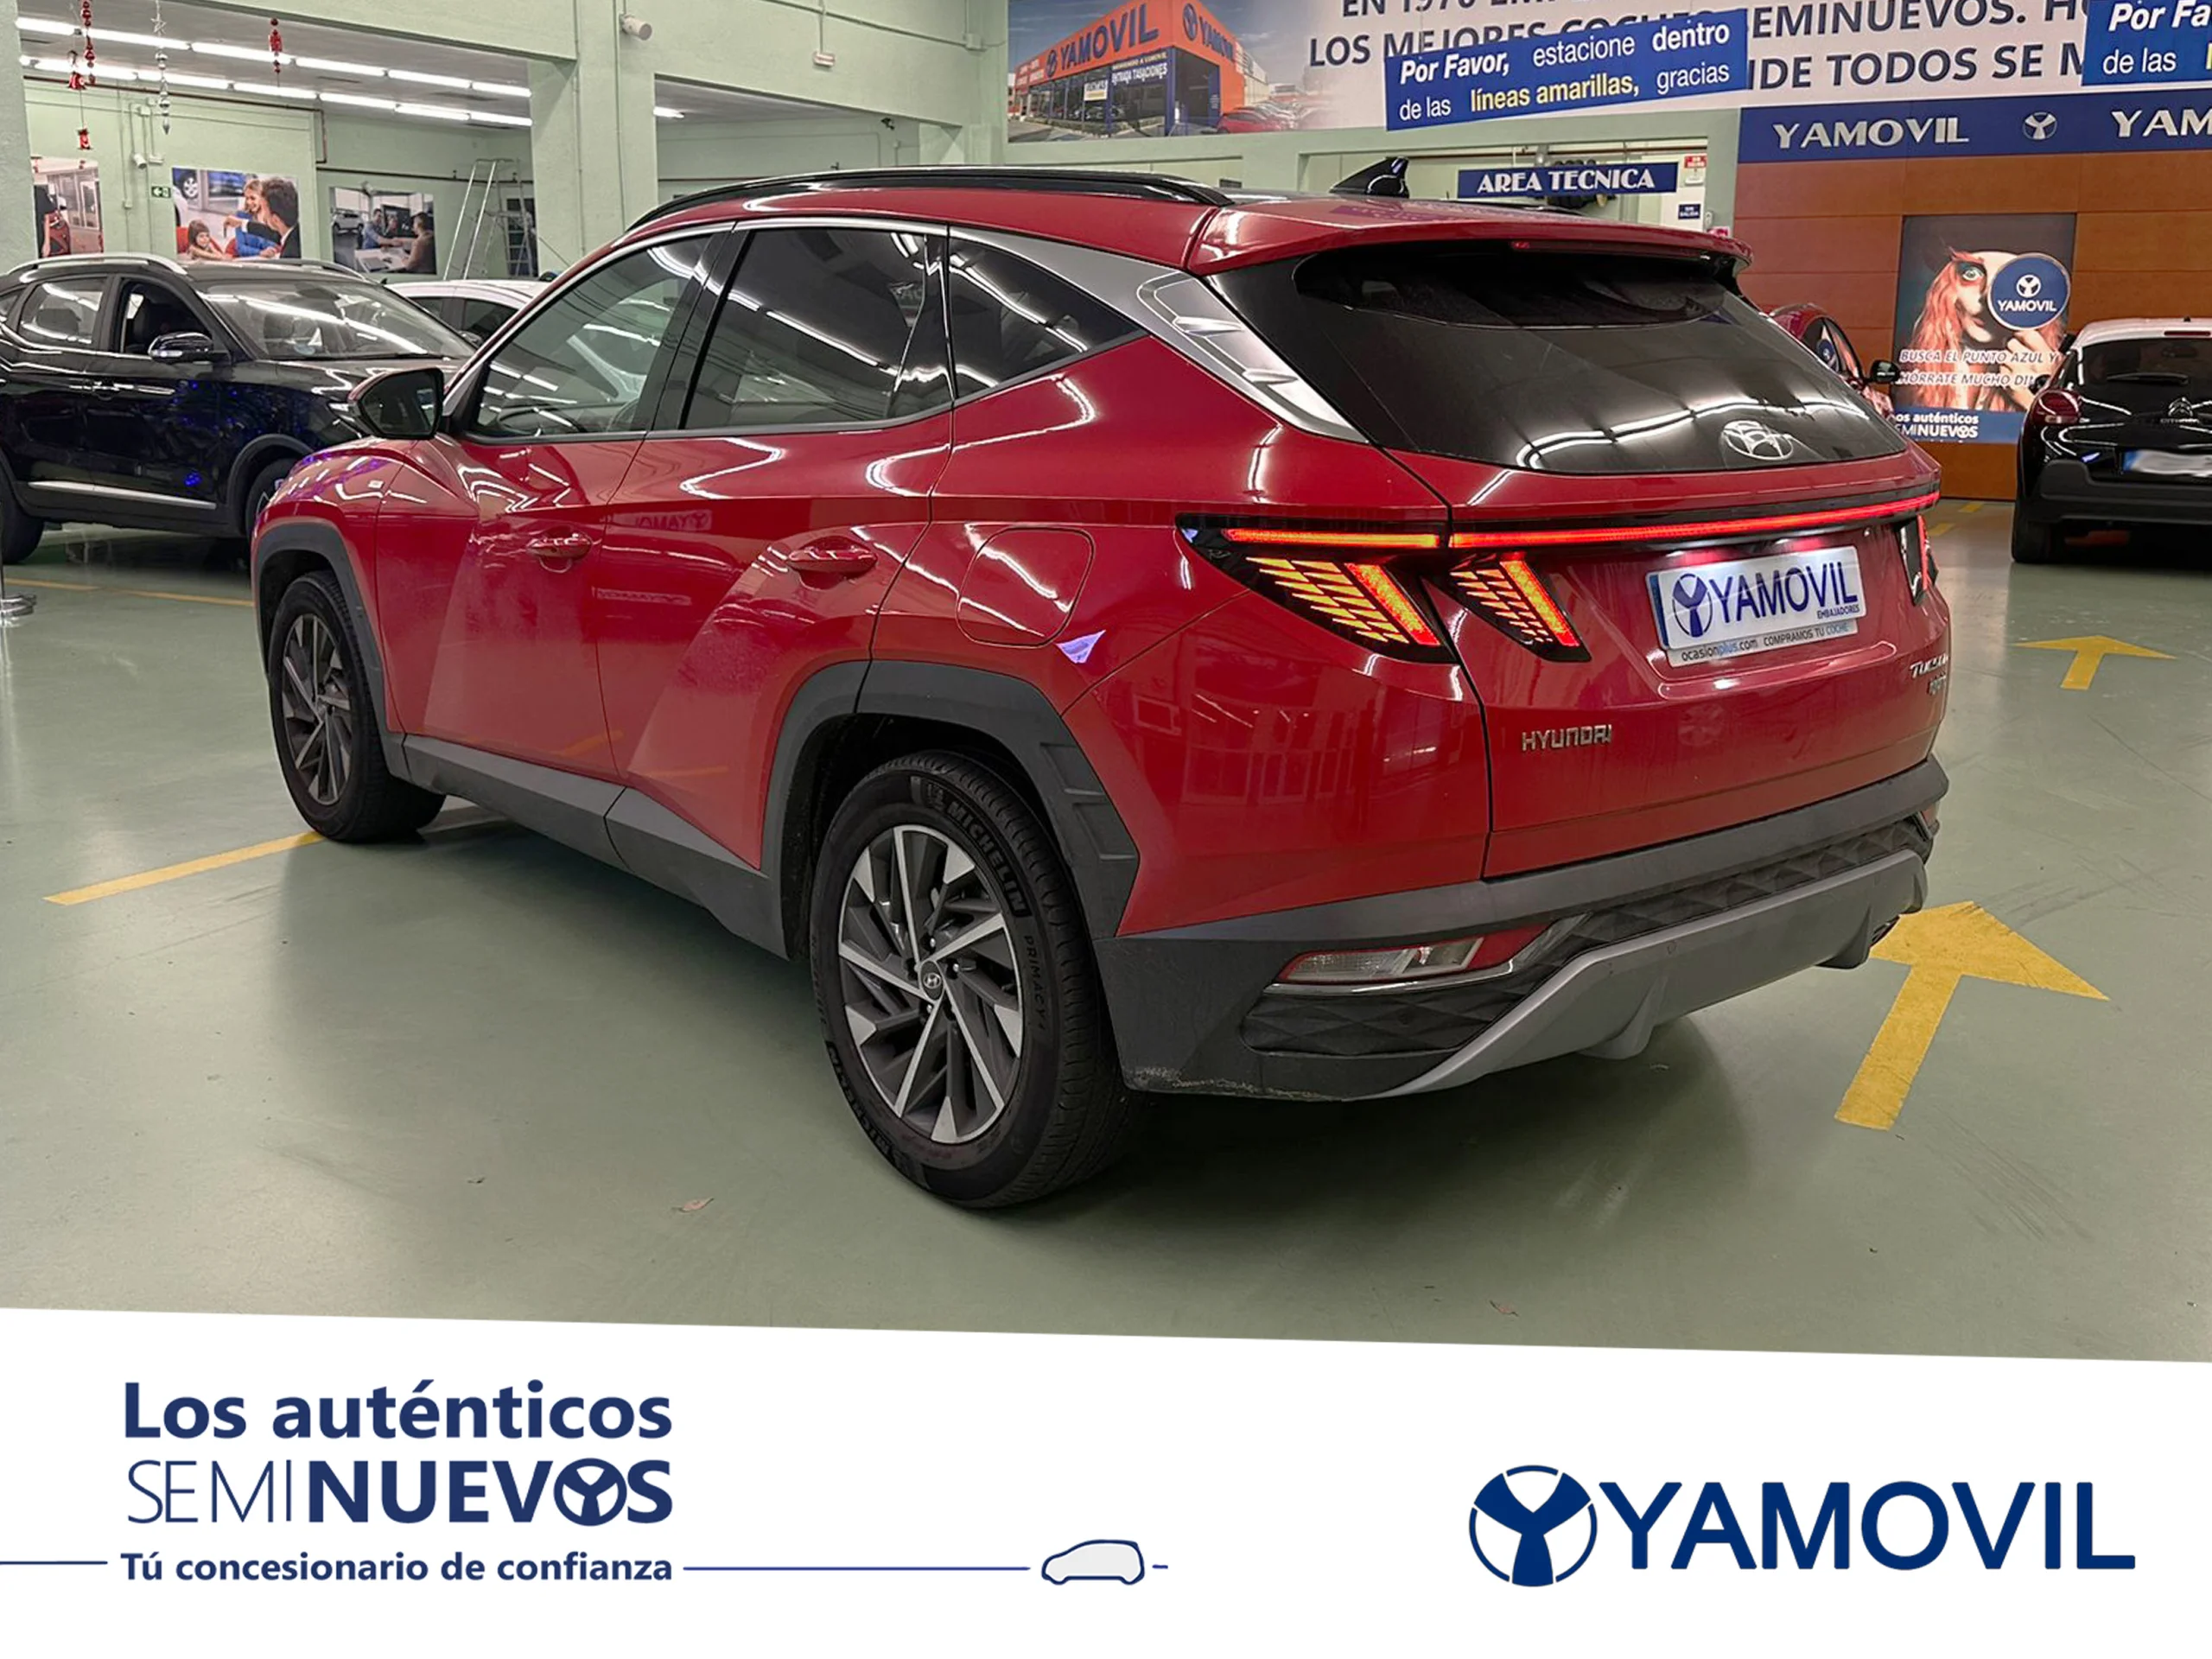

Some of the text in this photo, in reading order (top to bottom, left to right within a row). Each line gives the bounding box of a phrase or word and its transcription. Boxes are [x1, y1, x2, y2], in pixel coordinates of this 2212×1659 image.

[1751, 0, 2026, 38] EMINUEVOS.
[2108, 3, 2166, 32] Por
[1059, 3, 1160, 70] YAMOVIL
[1310, 35, 1371, 67] LOS
[1400, 22, 1730, 85] Por Favor, estacione dentro
[1826, 48, 1977, 86] TODOS
[1992, 44, 2044, 79] SE
[2102, 48, 2134, 75] de
[2141, 47, 2177, 73] las
[1399, 61, 1730, 121] de las líneas amarillas, gracias
[1772, 117, 1969, 149] YAMOVIL
[2111, 108, 2212, 138] YAM
[1477, 168, 1656, 194] AREA TECNICA
[1998, 300, 2057, 312] YAMOVIL
[1900, 349, 1942, 363] BUSCA
[1944, 350, 1958, 363] EL
[1962, 349, 2008, 364] PUNTO
[2010, 350, 2044, 364] AZUL
[1897, 369, 1957, 385] HÓRRATE
[1961, 372, 2011, 388] MUCHO
[1895, 423, 1979, 438] EMINUEVOS
[1896, 411, 1980, 424] os auténticos
[1708, 562, 1859, 623] YAMOVIL
[1816, 603, 1860, 620] EMBAJADORES
[1681, 622, 1850, 662] ocasionplus.com COMPRAMOS TU COCHE
[1522, 724, 1612, 751] HYUNDAI
[945, 798, 1028, 916] MICHELIN
[1023, 934, 1046, 1019] PRIMACY
